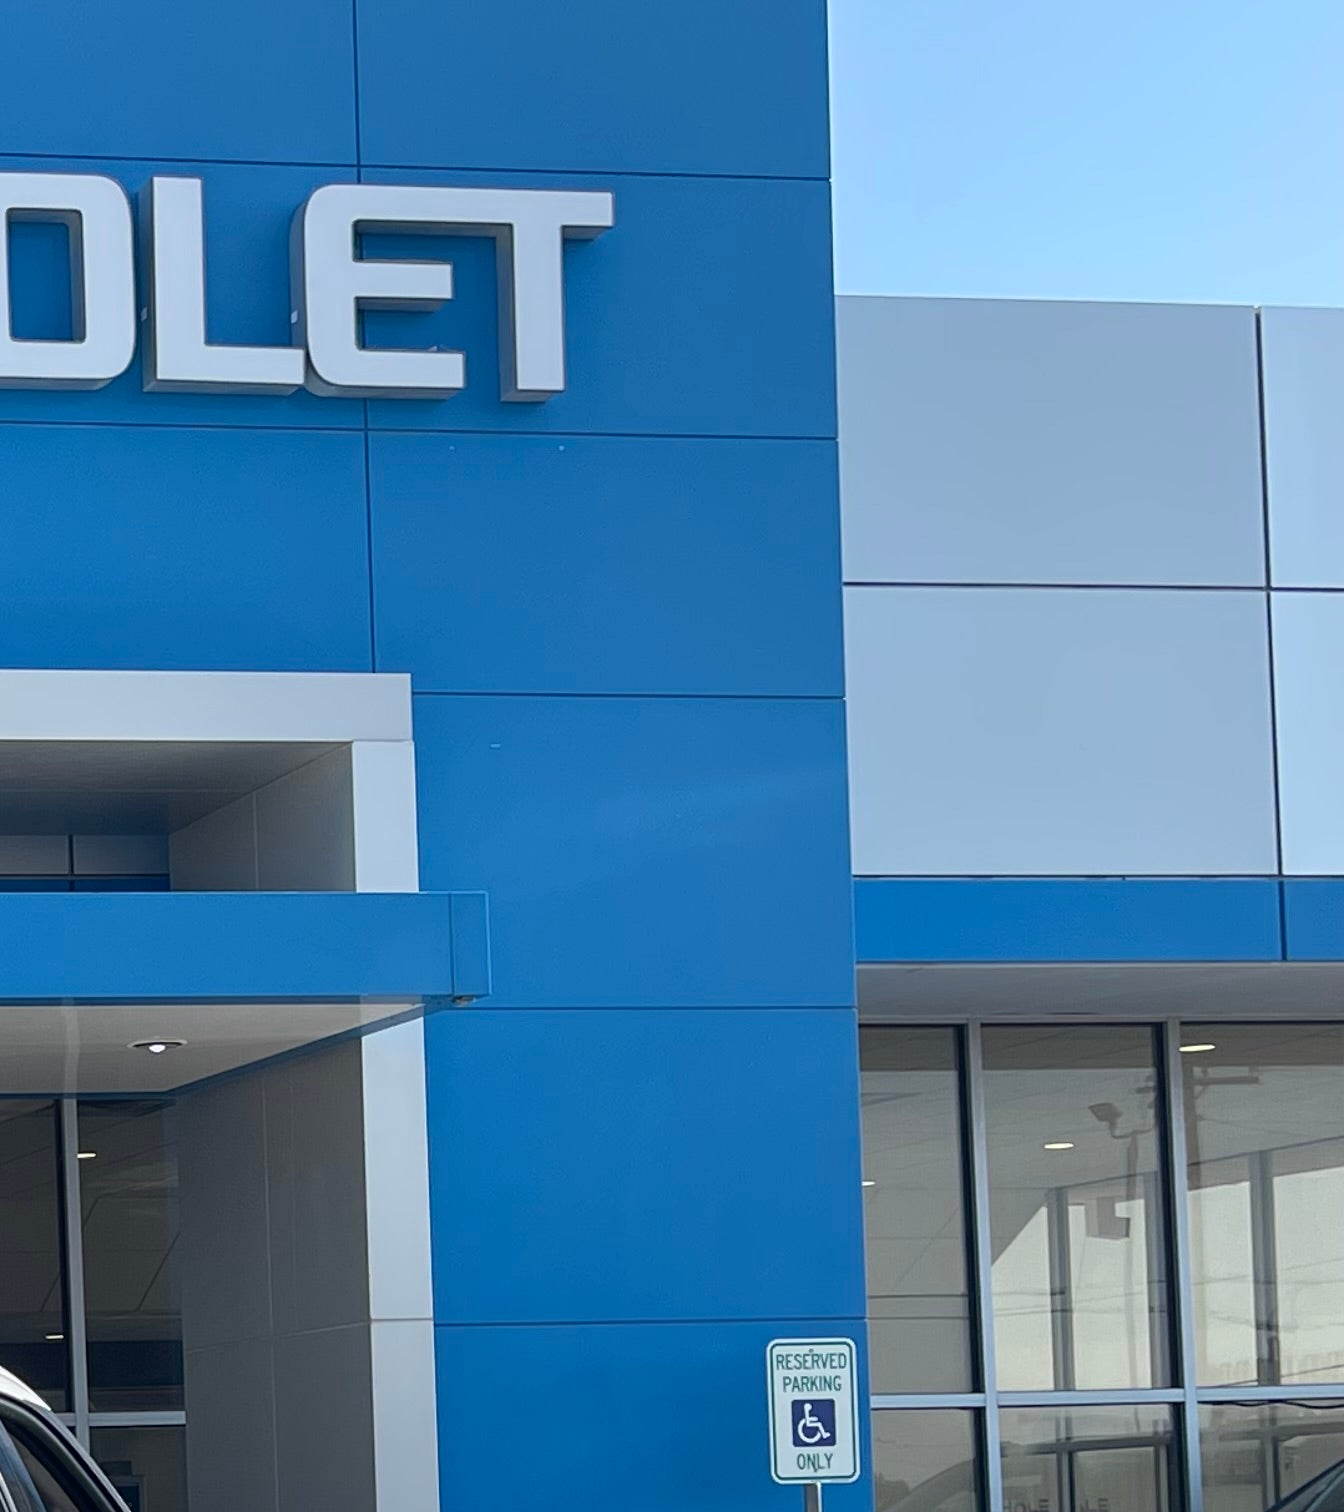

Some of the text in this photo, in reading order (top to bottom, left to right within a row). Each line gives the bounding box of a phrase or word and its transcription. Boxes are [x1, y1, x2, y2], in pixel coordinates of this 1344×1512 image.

[775, 1352, 847, 1371] RESERVED
[782, 1375, 842, 1392] PARKING
[796, 1453, 834, 1470] ONLY
